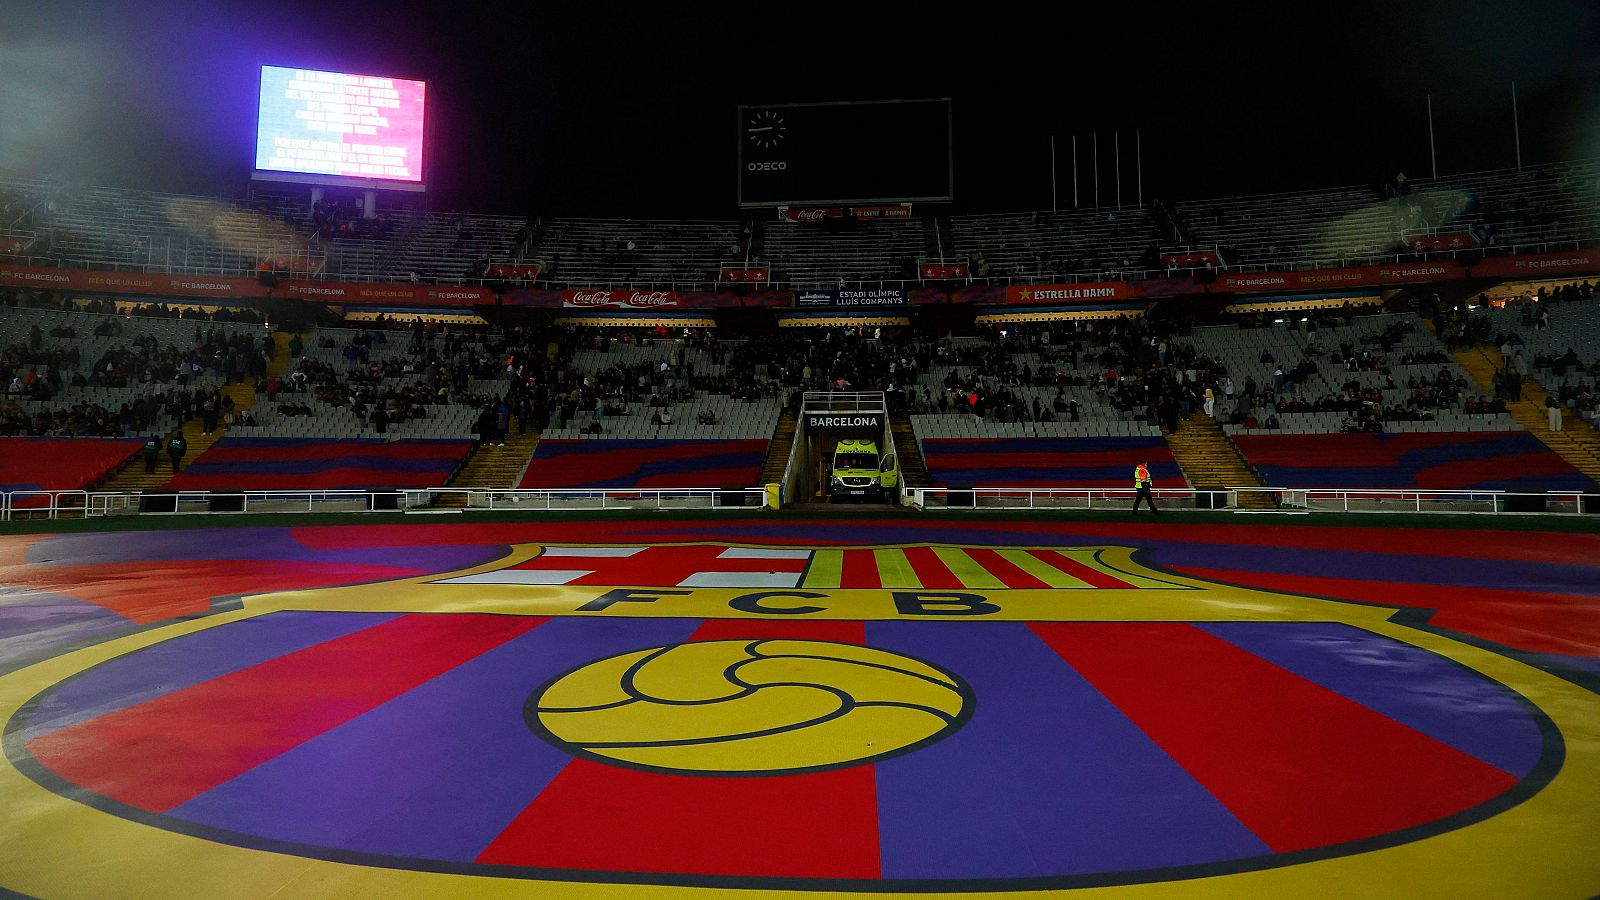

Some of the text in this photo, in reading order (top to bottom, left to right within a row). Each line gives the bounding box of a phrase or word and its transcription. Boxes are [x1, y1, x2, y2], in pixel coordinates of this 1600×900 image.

[748, 161, 787, 171] ODECO
[1540, 257, 1589, 268] BARCELONA
[1402, 267, 1445, 276] BARCELONA
[25, 273, 70, 282] BARCELONA
[1246, 277, 1284, 285] BARCELONA
[308, 287, 345, 296] BARCELONA
[446, 292, 480, 300] BARCELONA
[868, 289, 900, 298] OLÍMPIC
[1034, 287, 1115, 300] ESTRELLA DAMM
[573, 291, 614, 304] Coca-Cola
[630, 291, 671, 304] Coca-Cola
[836, 297, 859, 306] LLUÍS
[860, 297, 903, 305] COMPANYS
[810, 417, 878, 427] BARCELONA
